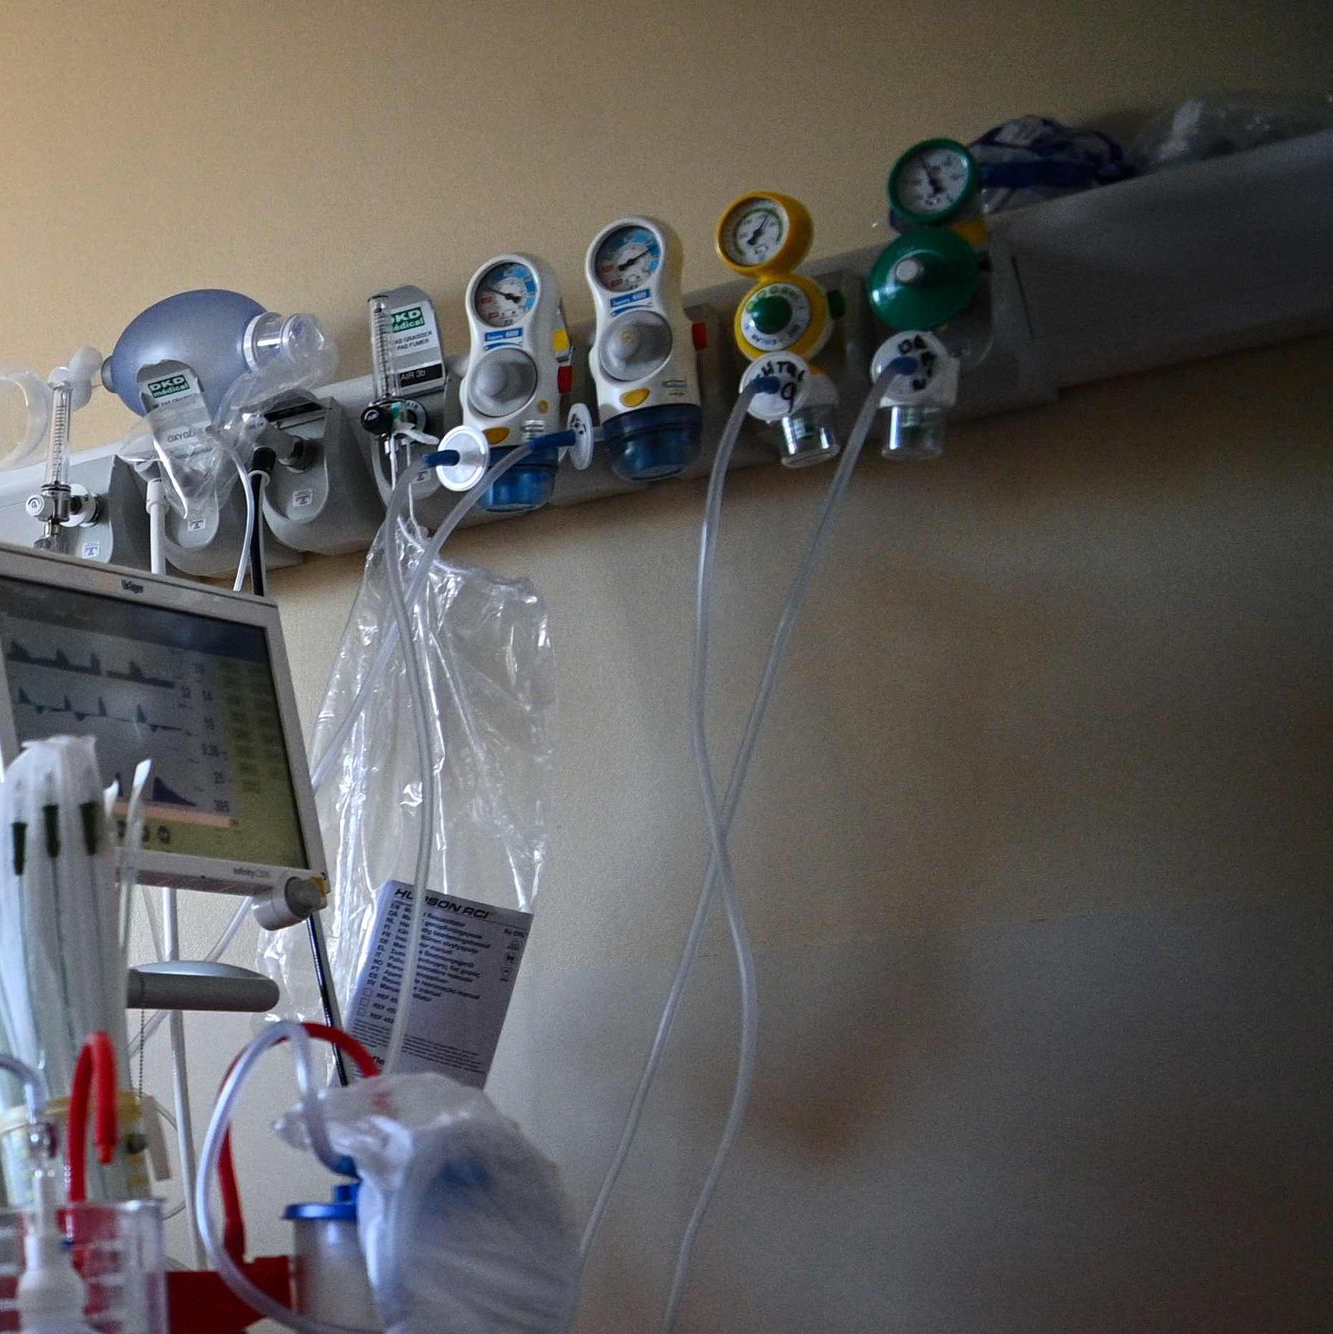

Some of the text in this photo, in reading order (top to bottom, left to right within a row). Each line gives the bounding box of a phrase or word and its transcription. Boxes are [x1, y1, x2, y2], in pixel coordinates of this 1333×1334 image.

[400, 371, 415, 380] AIR
[149, 377, 185, 391] DKD
[394, 888, 462, 913] HUSON
